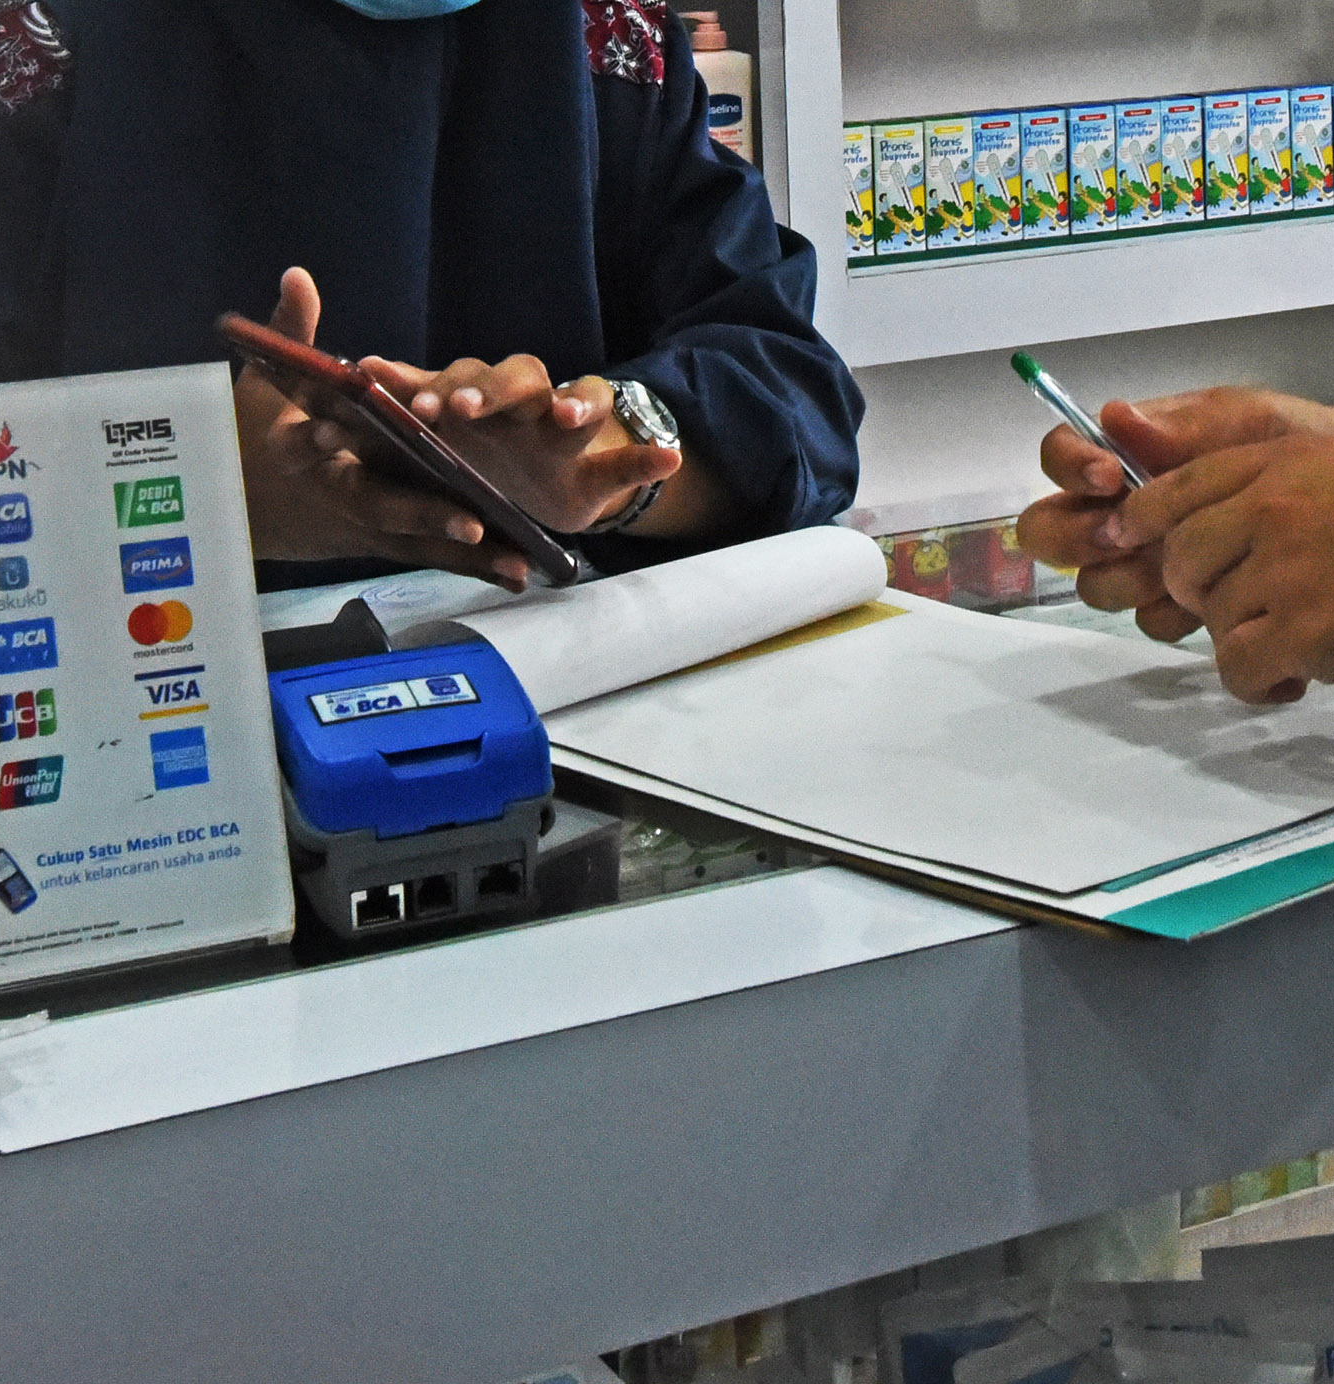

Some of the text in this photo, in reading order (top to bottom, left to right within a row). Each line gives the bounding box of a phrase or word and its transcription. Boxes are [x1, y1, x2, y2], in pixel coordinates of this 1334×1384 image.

[880, 149, 920, 163] Ibuprofen
[930, 144, 969, 159] Ibuprofen
[138, 483, 174, 502] DEBIT
[150, 499, 180, 515] BCA
[131, 554, 184, 574] PRIMA
[12, 628, 47, 649] BCA
[133, 641, 195, 660] mastercard
[145, 679, 202, 704] VISA
[357, 695, 403, 713] BCA
[2, 769, 60, 787] UnionPay
[37, 822, 241, 867] Cukup Satu Mesin EDC BCA
[40, 844, 242, 891] untuk kelancaran usaha anda
